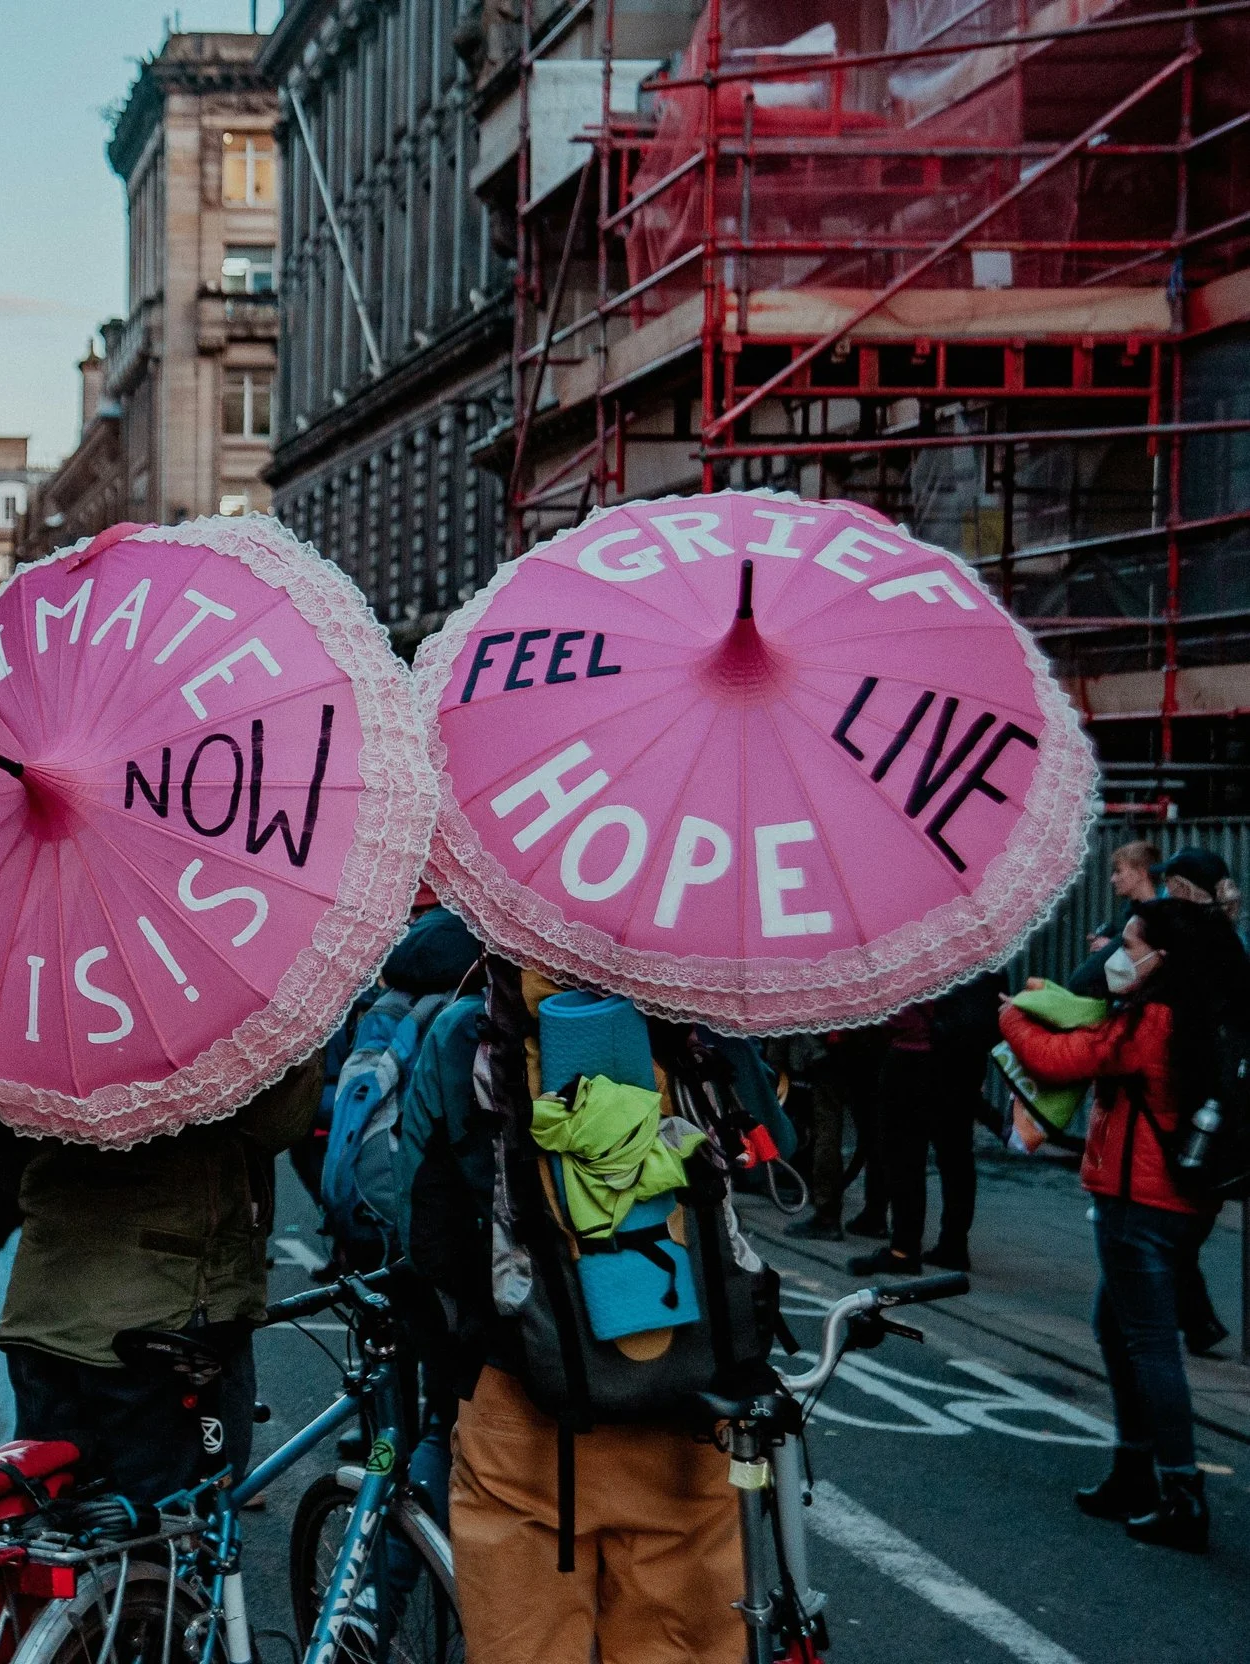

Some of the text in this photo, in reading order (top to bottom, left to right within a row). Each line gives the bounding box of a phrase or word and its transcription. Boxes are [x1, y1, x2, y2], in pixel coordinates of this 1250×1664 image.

[577, 509, 978, 611] GRIEF
[459, 628, 622, 704] FEEL
[124, 704, 334, 868] NOW
[489, 739, 833, 939] HOPE
[831, 675, 1039, 875] LIVE
